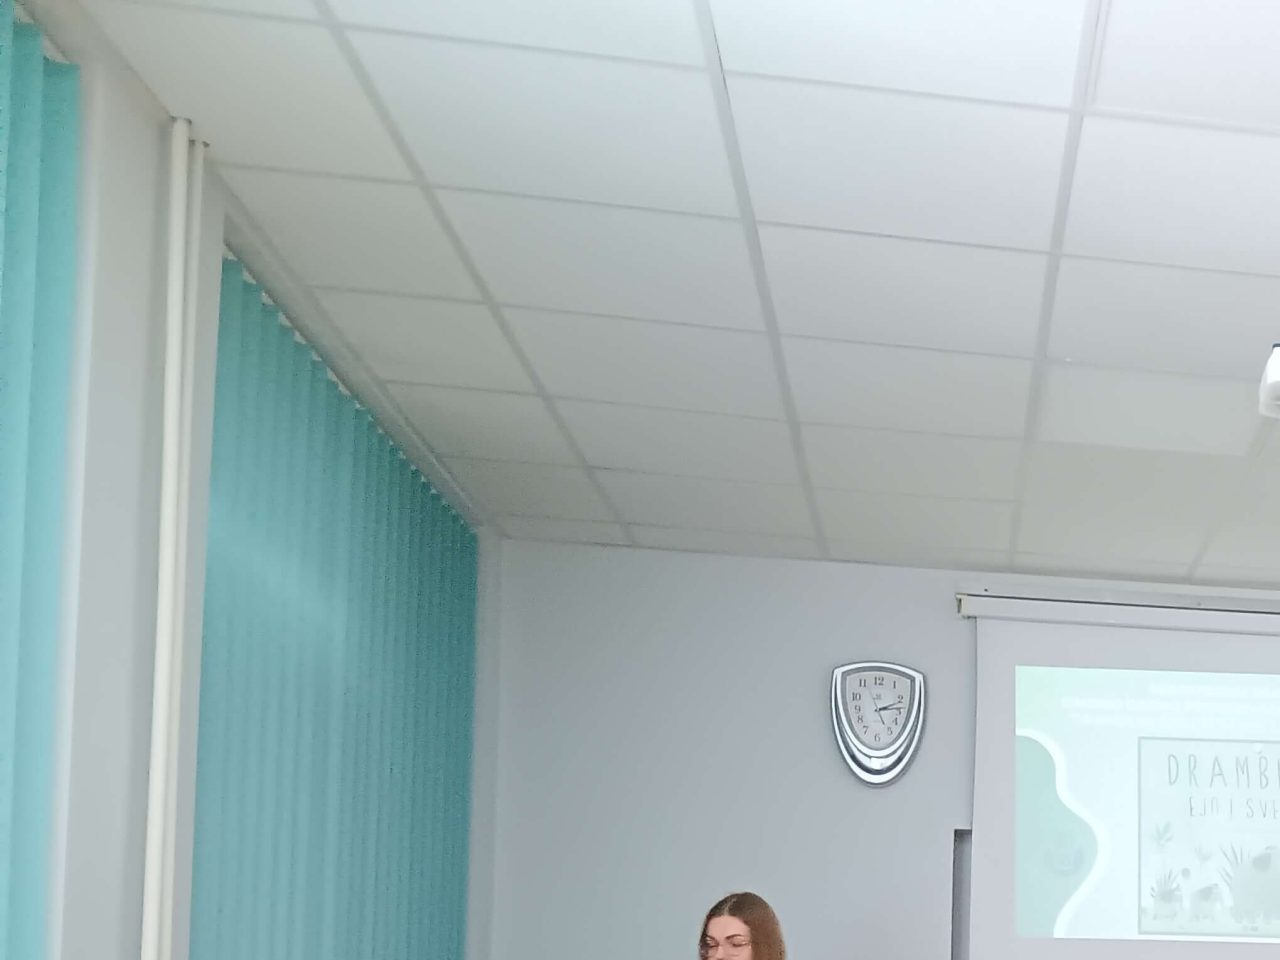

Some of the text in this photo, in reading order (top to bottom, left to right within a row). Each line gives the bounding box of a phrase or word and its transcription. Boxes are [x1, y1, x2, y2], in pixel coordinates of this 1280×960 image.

[859, 679, 867, 688] 11
[874, 676, 885, 686] 12
[852, 692, 861, 701] 10
[897, 695, 904, 704] 2
[855, 705, 861, 714] 9
[857, 715, 864, 724] 8
[892, 717, 898, 726] 4
[863, 725, 869, 735] 7
[887, 726, 893, 736] 5
[874, 733, 881, 743] 6
